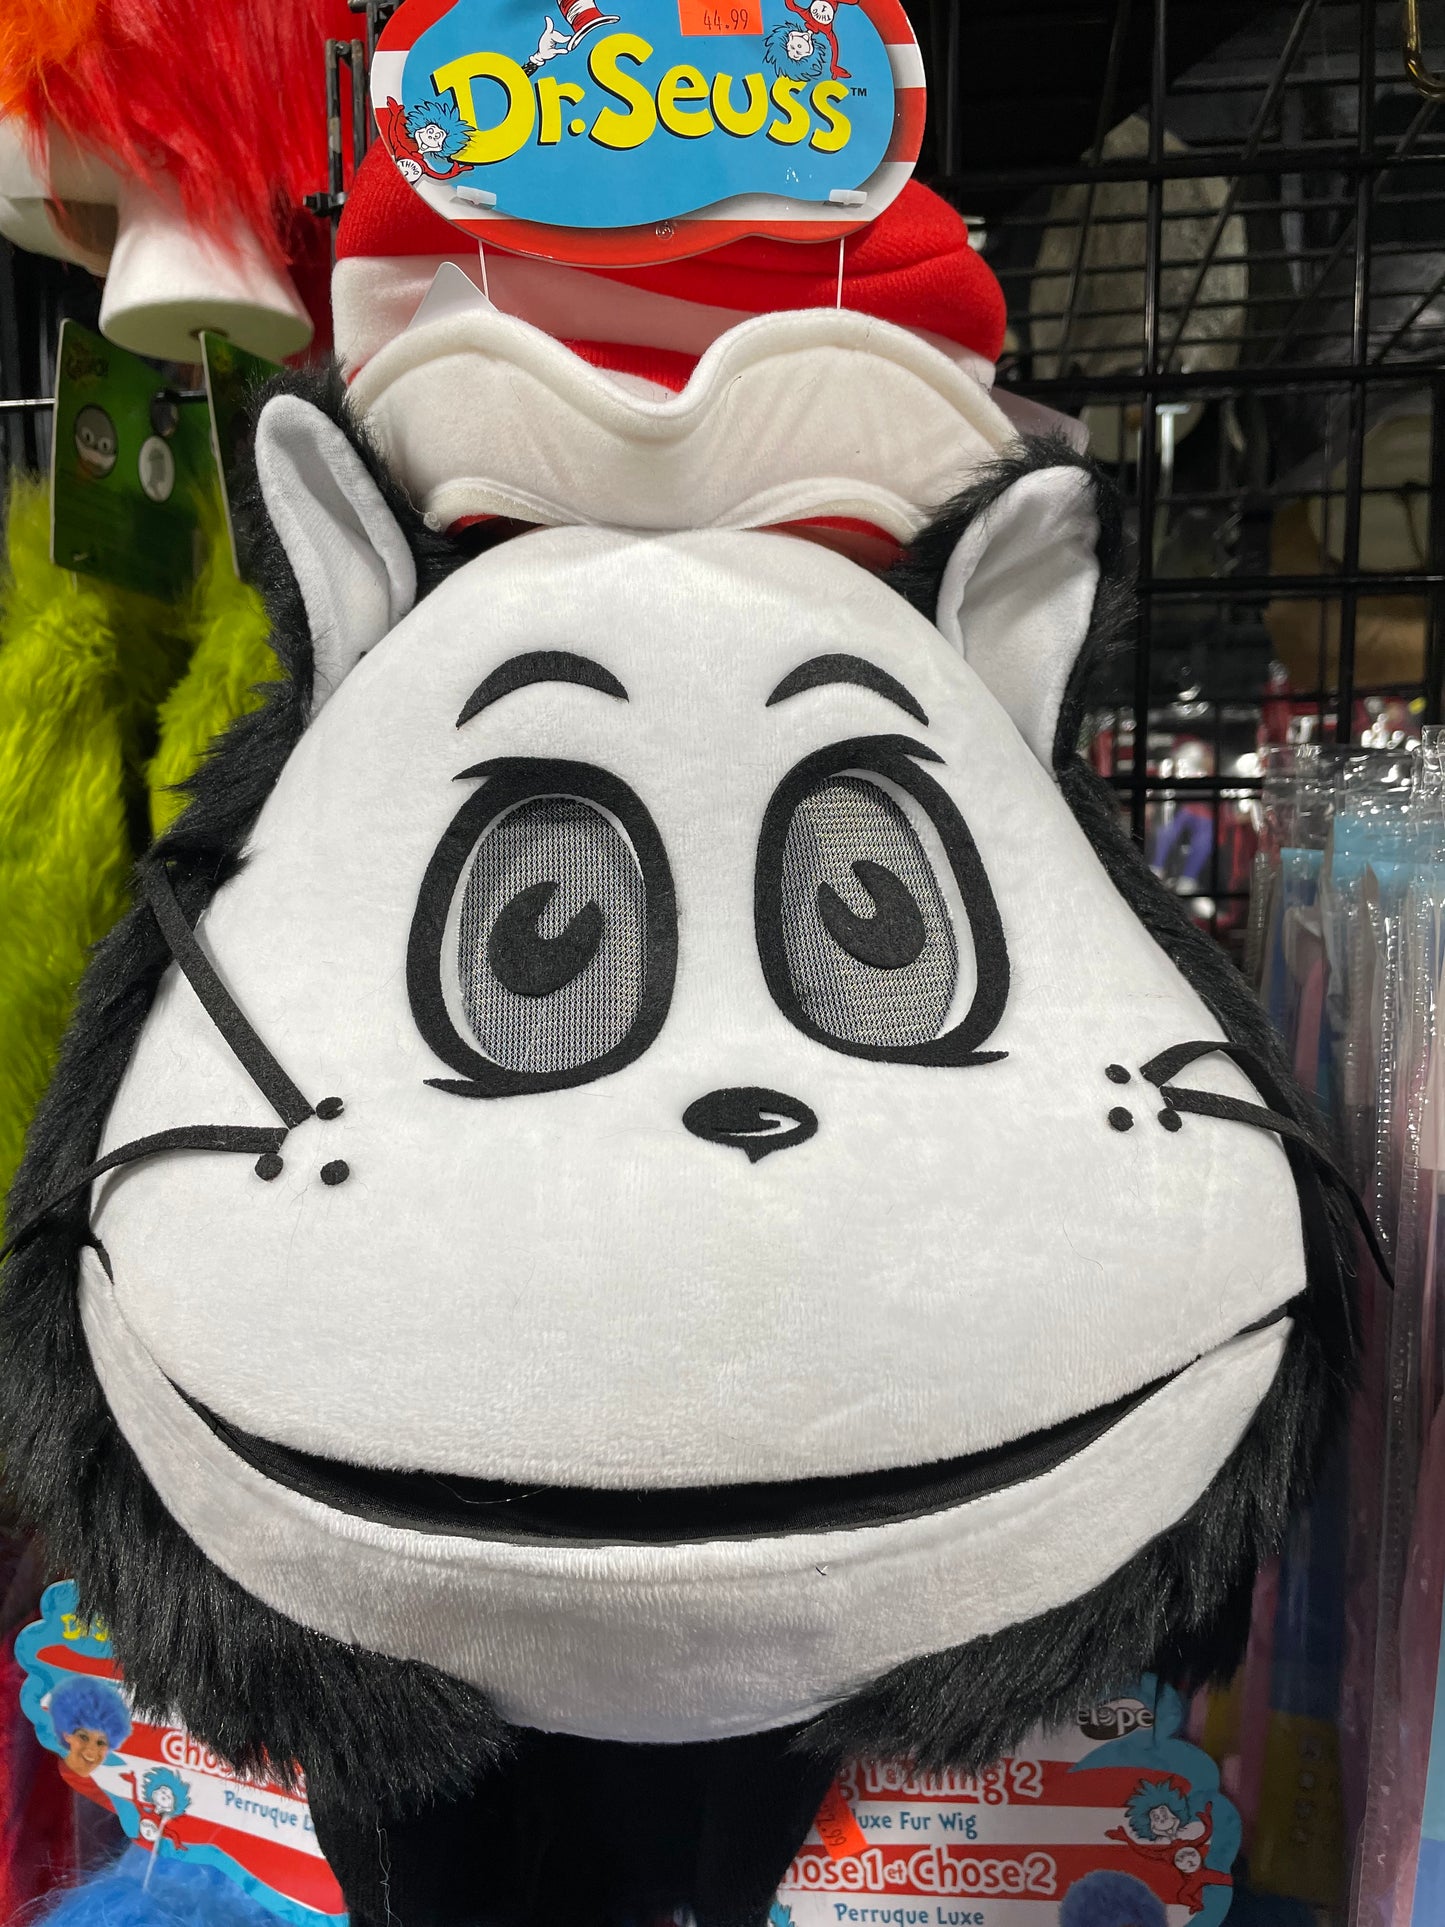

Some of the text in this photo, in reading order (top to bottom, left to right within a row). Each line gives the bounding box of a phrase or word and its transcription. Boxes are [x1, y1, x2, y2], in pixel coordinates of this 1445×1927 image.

[703, 9, 748, 30] 44.99
[812, 8, 831, 22] THING
[430, 33, 867, 165] Dr. Seuss TM
[400, 160, 419, 176] THING
[1013, 1759, 1040, 1795] 2
[224, 1790, 298, 1829] Perruque
[900, 1811, 930, 1829] Fur
[939, 1811, 978, 1840] Wig
[886, 1864, 907, 1882] et
[912, 1846, 1022, 1890] Chose
[1027, 1853, 1053, 1892] 2
[834, 1903, 984, 1927] Perruque Luxe
